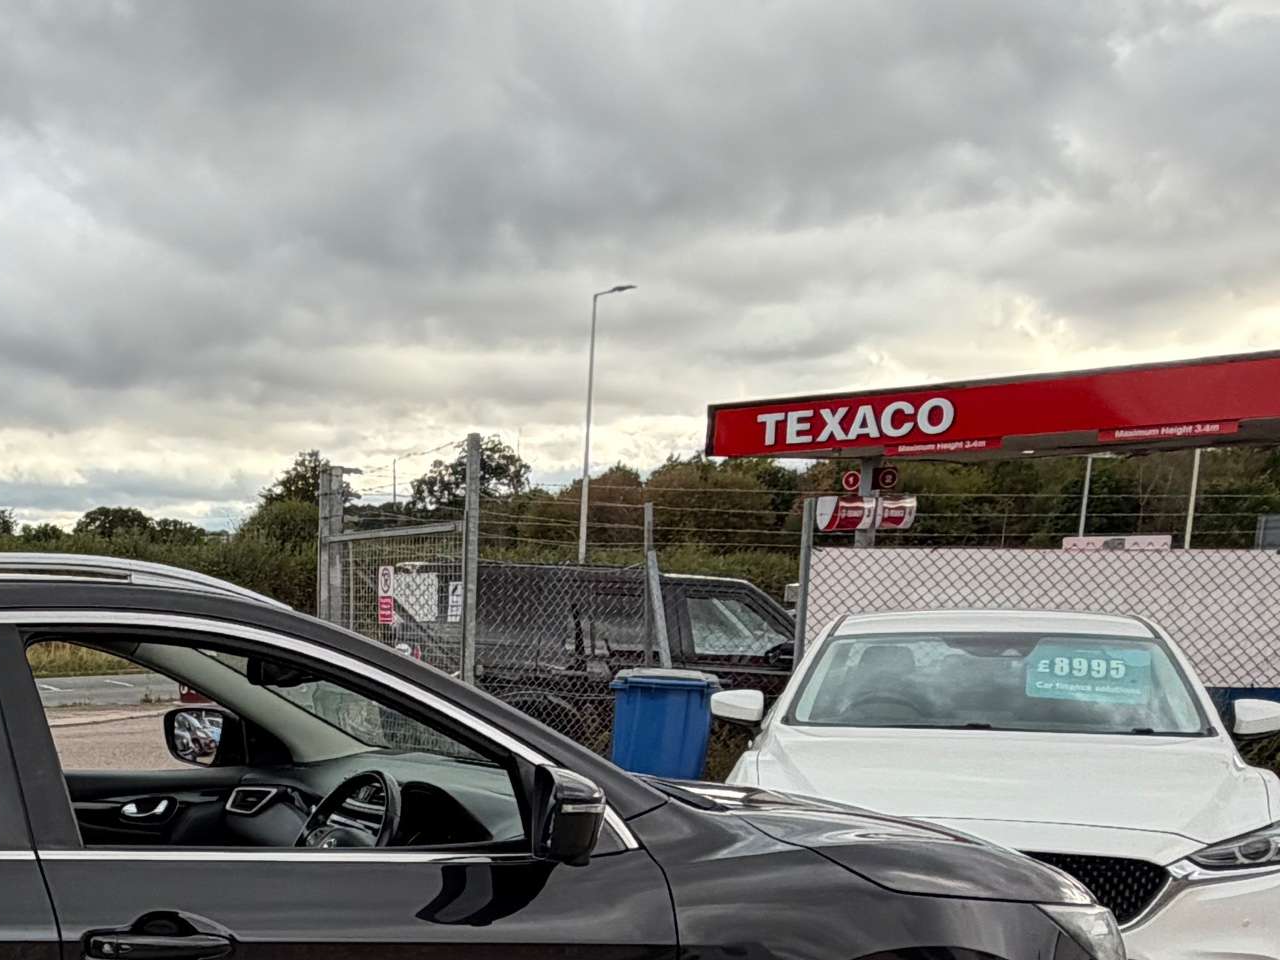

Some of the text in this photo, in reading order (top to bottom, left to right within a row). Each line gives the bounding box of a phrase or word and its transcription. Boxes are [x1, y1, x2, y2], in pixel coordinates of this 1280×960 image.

[757, 397, 955, 446] TEXACO
[1161, 425, 1193, 436] Height
[1194, 423, 1220, 434] 3.4m
[1037, 657, 1126, 679] £8995
